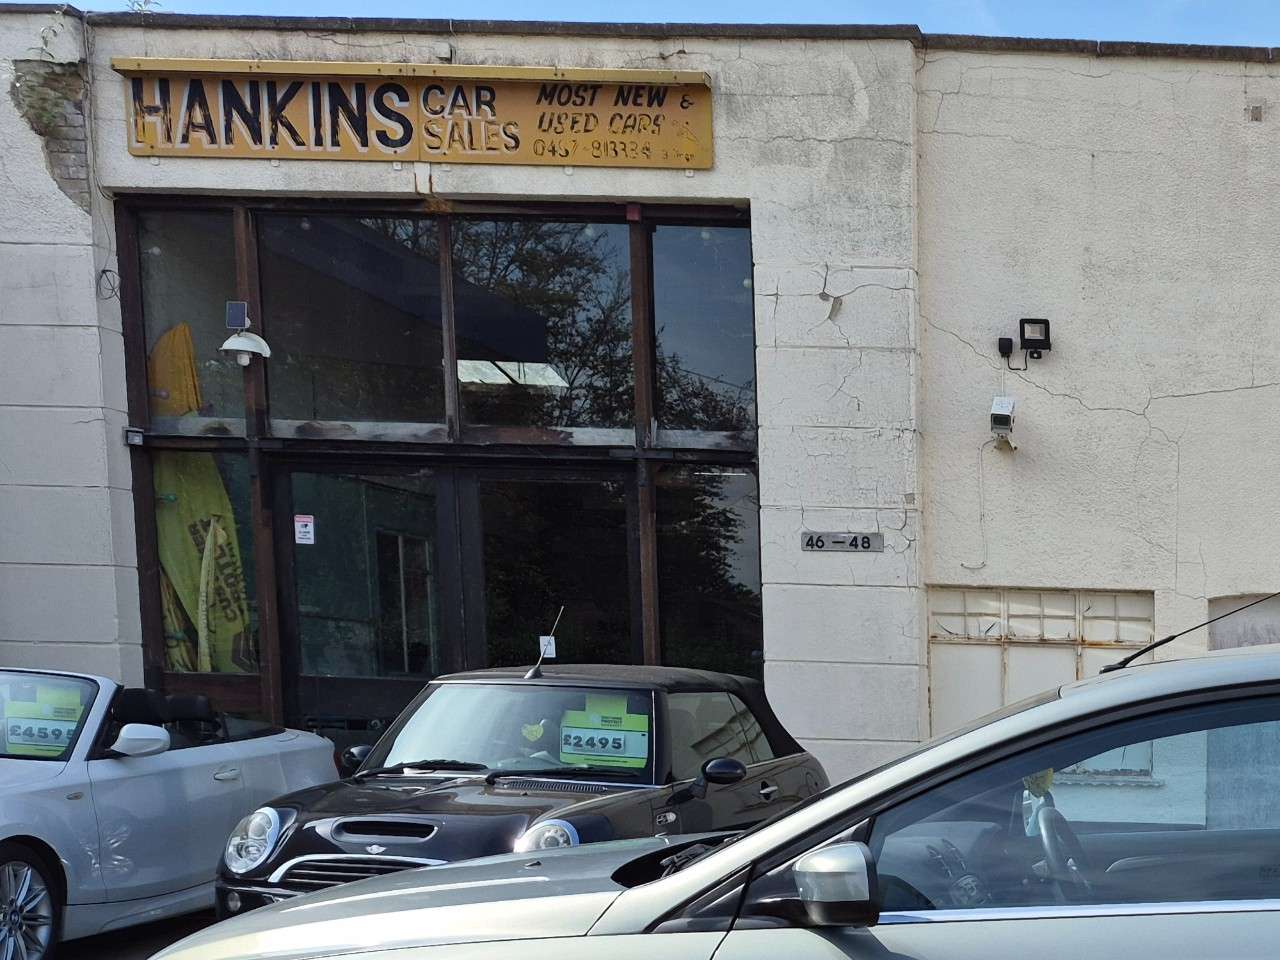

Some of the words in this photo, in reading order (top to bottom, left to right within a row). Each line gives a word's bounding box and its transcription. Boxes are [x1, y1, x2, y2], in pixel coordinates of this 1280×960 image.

[421, 84, 497, 118] CAR
[536, 84, 602, 107] MOST
[613, 85, 669, 108] NEW
[680, 94, 695, 109] &
[129, 77, 414, 150] HANKINS
[538, 111, 599, 134] USED
[608, 112, 666, 135] CARS
[422, 119, 521, 153] SALES
[805, 535, 825, 549] 46
[849, 535, 871, 549] 48
[9, 724, 75, 740] £4595
[563, 734, 622, 749] £2495
